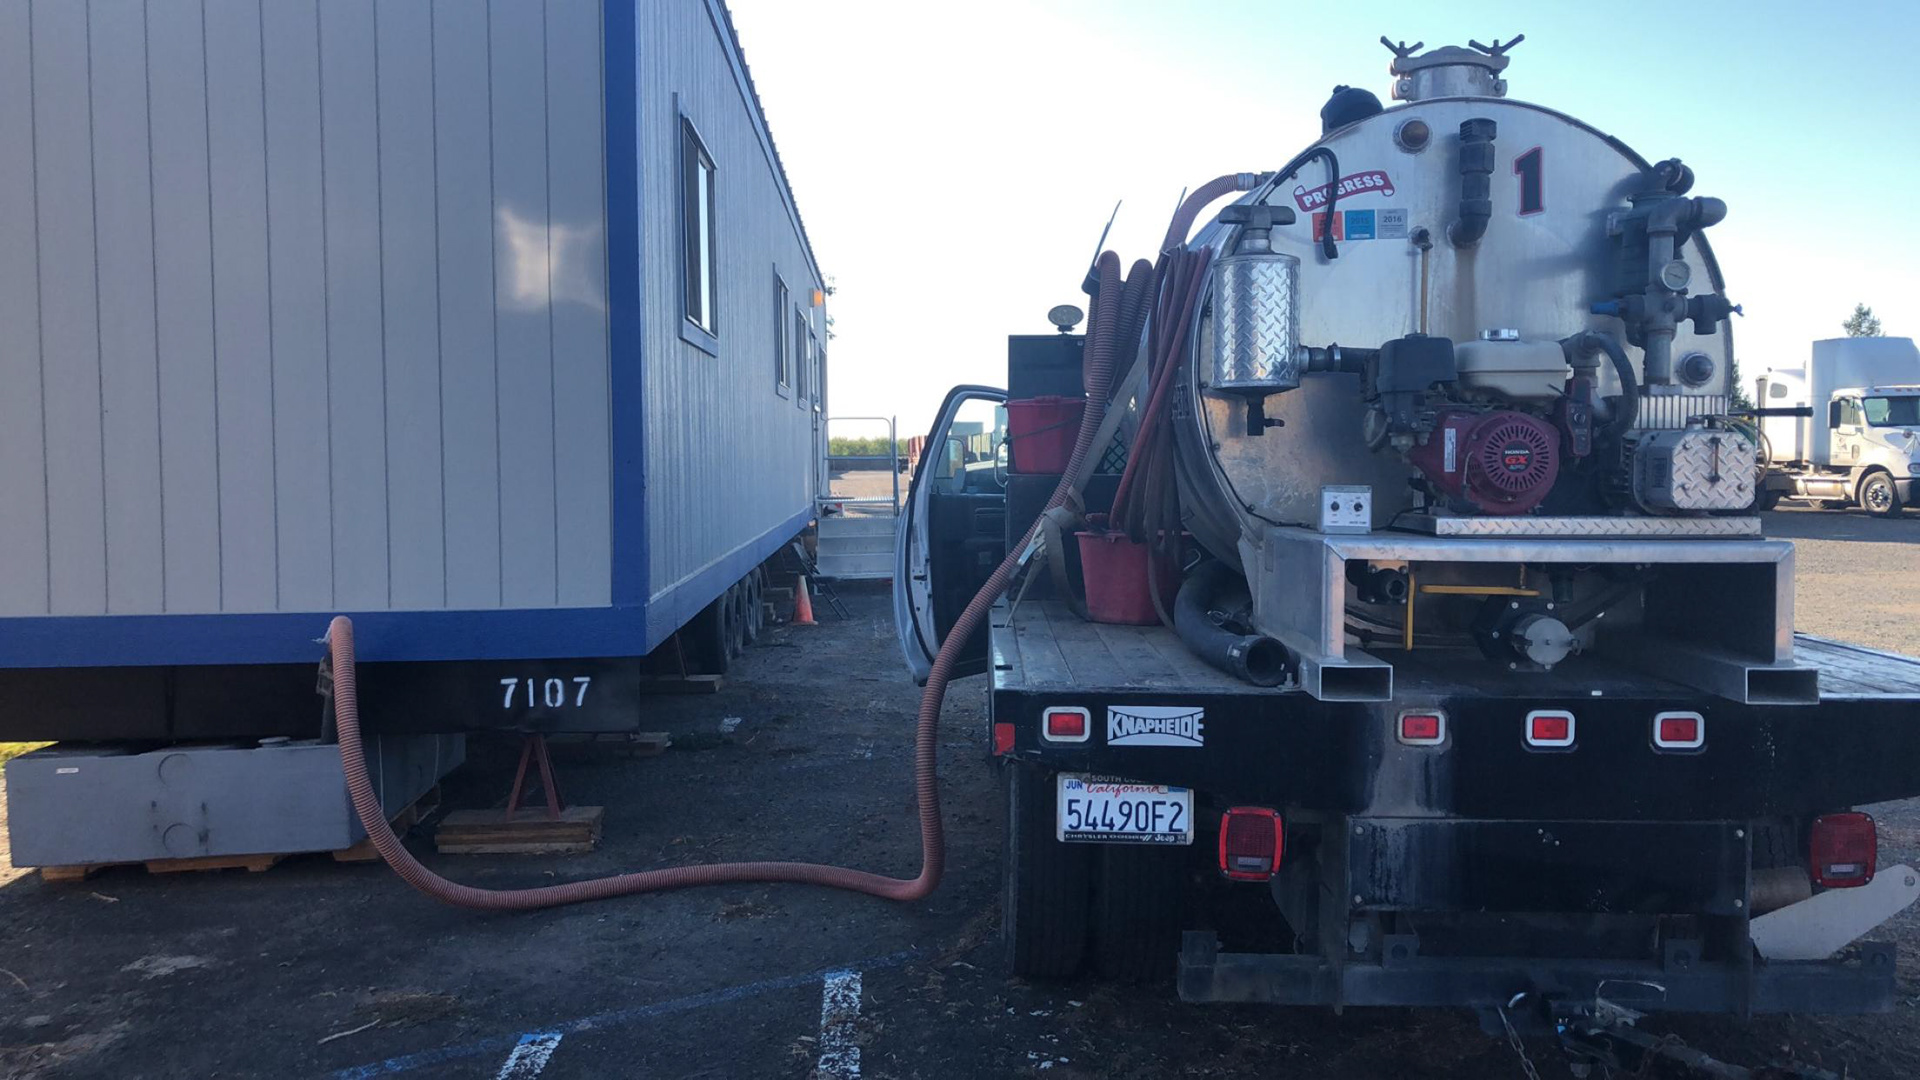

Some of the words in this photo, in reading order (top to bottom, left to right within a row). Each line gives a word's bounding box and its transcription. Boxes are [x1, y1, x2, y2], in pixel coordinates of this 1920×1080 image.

[1514, 145, 1544, 216] 1
[1383, 215, 1402, 223] 2016
[500, 676, 591, 708] 7107
[1107, 709, 1205, 743] KNAPHEIDE
[1066, 780, 1083, 790] JUN
[1086, 783, 1168, 798] California
[1067, 799, 1184, 832] 54490F2
[1065, 832, 1108, 840] CHRYSLER
[1154, 833, 1175, 842] Jeep
